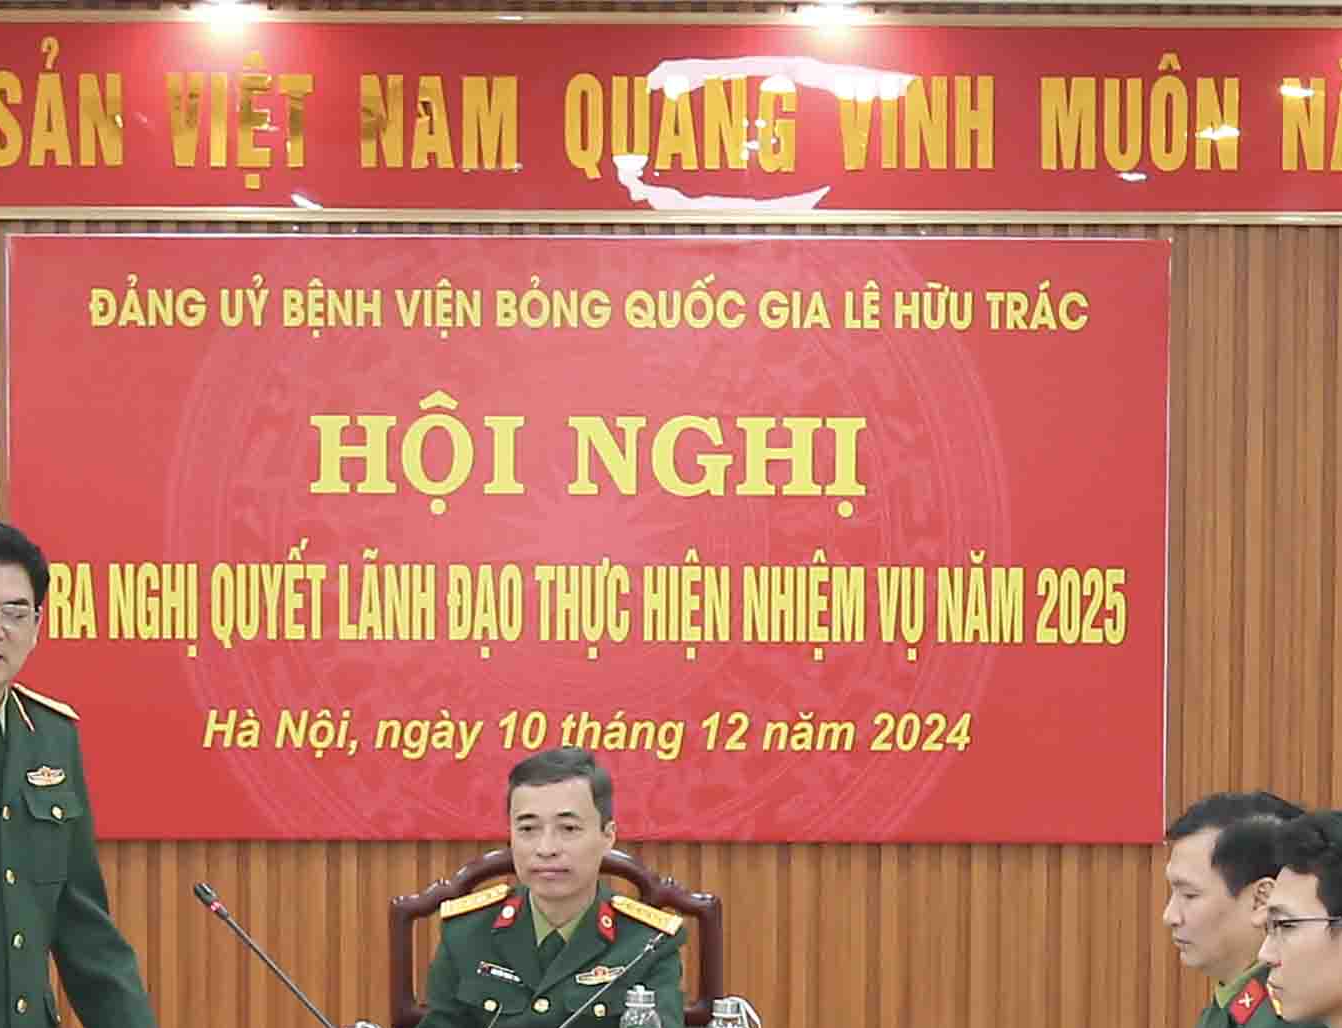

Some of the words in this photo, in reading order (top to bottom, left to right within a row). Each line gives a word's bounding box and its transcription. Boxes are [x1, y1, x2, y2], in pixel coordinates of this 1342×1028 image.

[163, 50, 315, 190] VIỆT
[361, 74, 519, 171] NAM
[564, 74, 798, 179] QUANG
[838, 74, 994, 171] VINH
[1041, 53, 1240, 173] MUÔN
[89, 274, 207, 329] ĐẢNG
[220, 274, 268, 329] UỶ
[283, 278, 384, 338] BỆNH
[398, 278, 484, 338] VIỆN
[496, 274, 612, 330] BỎNG
[625, 274, 747, 332] QUỐC
[760, 287, 831, 329] GIA
[843, 279, 884, 329] LÊ
[895, 279, 975, 330] HỮU
[987, 279, 1090, 331] TRÁC
[309, 389, 525, 514] HỘI
[567, 414, 868, 519] NGHỊ
[48, 562, 97, 641] RA
[108, 561, 199, 661] NGHỊ
[210, 538, 328, 649] QUYẾT
[338, 547, 437, 642] LÃNH
[447, 562, 524, 661] ĐẠO
[534, 559, 632, 661] THỰC
[642, 550, 731, 661] HIỆN
[743, 549, 866, 661] NHIỆM
[876, 566, 926, 662] VỤ
[937, 552, 1025, 644] NĂM
[1035, 567, 1128, 645] 2025
[203, 708, 260, 749] Hà
[274, 707, 360, 759] Nội,
[374, 718, 484, 760] ngày
[498, 710, 548, 751] 10
[561, 711, 684, 761] tháng
[700, 710, 750, 752] 12
[763, 714, 856, 753] năm
[870, 710, 971, 754] 2024
